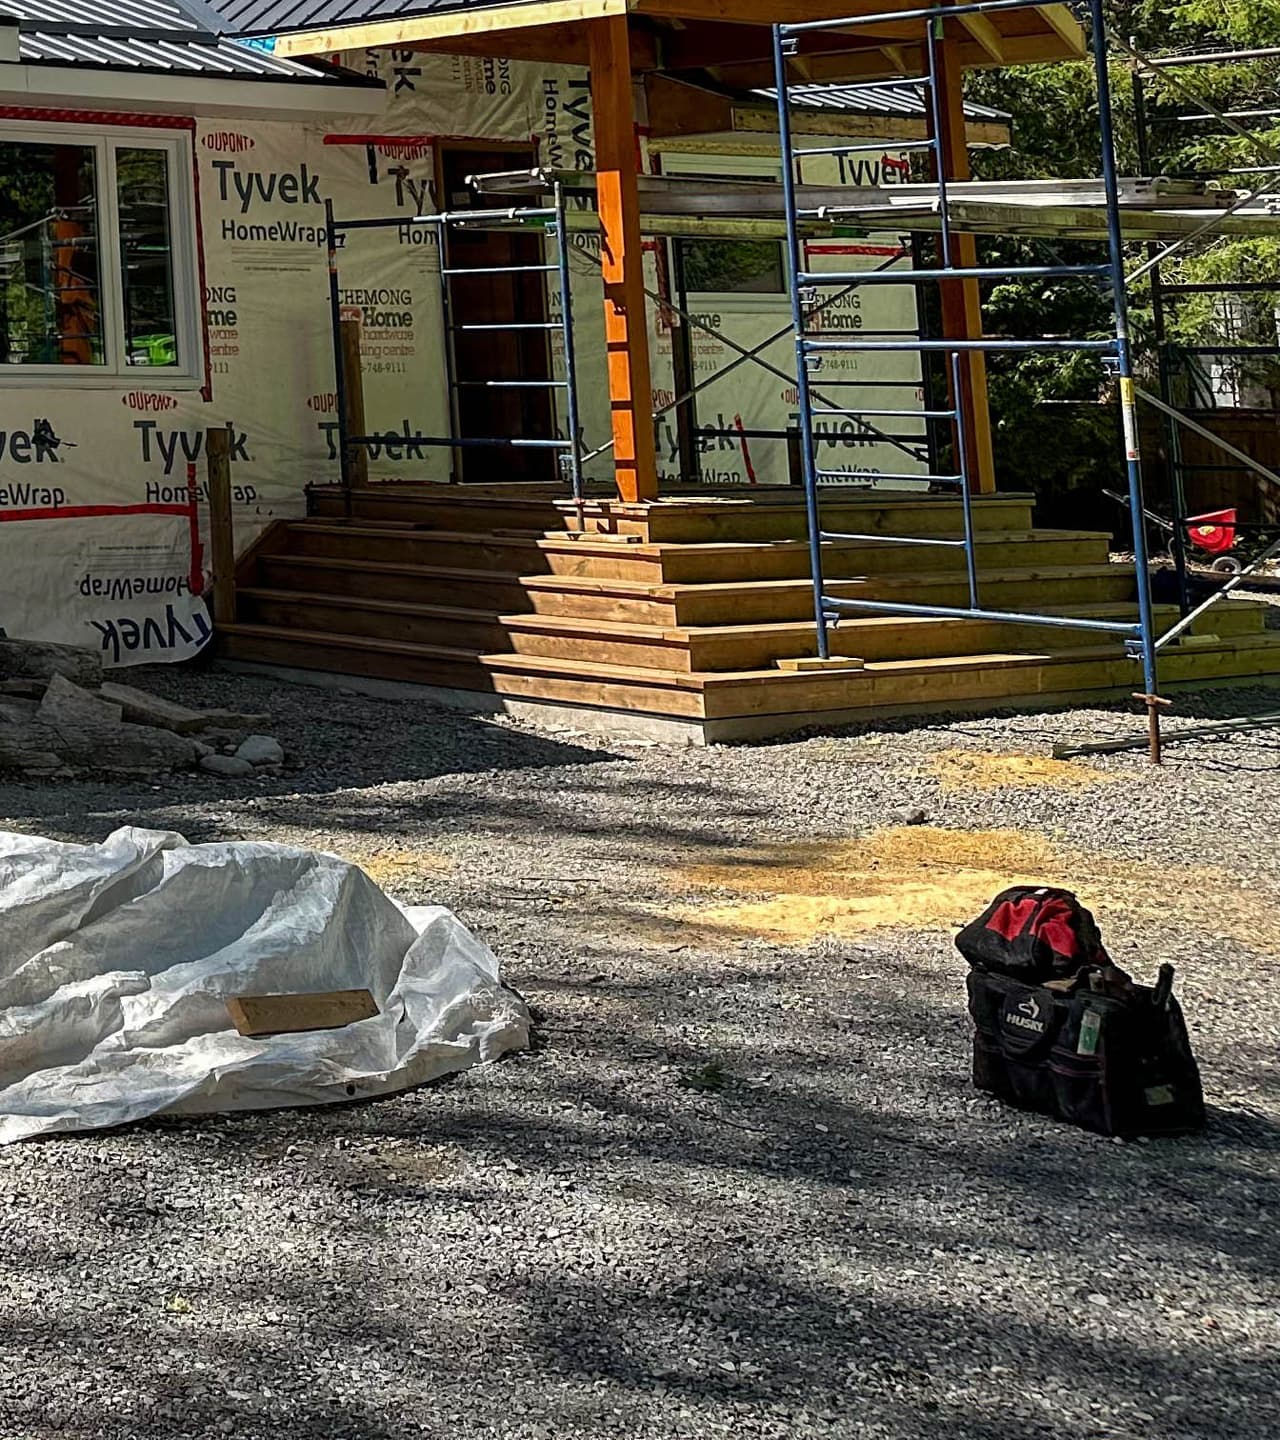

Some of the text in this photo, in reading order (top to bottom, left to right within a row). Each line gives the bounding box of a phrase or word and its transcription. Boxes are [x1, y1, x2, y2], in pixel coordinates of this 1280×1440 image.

[208, 132, 250, 153] DUPONT
[212, 160, 322, 213] Tyvek
[222, 219, 327, 248] HomeWrap
[362, 307, 413, 327] Home
[821, 311, 863, 329] Home
[133, 419, 249, 475] Tyvk
[91, 604, 213, 663] Tyvek
[1006, 1013, 1044, 1033] HUSKY
